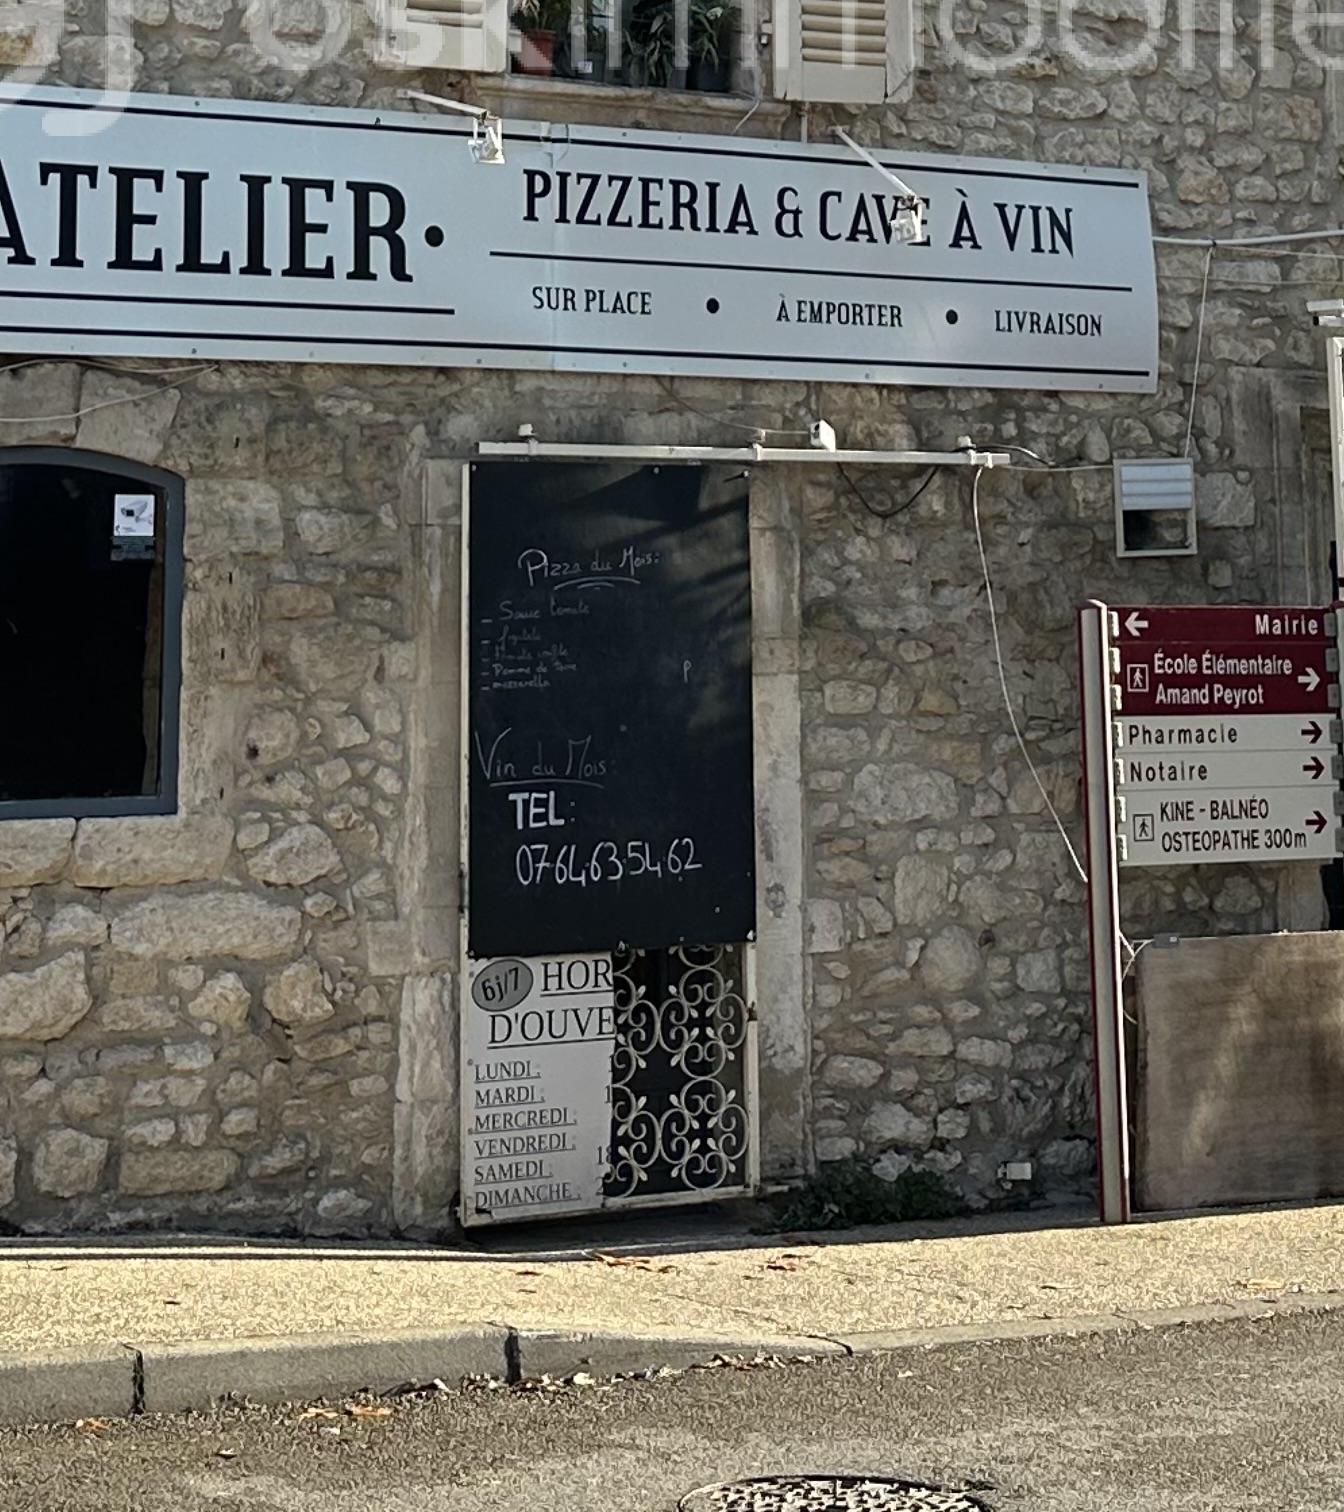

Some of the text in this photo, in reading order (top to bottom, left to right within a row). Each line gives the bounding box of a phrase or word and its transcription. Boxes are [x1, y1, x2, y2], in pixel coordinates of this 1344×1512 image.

[522, 168, 759, 236] PIZZERIA
[774, 186, 804, 239] &
[948, 188, 983, 250] À
[993, 201, 1075, 257] VIN
[531, 285, 652, 316] SUR PLACE
[775, 294, 904, 328] À EMPORTER
[994, 309, 1103, 337] LIVRAISON
[517, 548, 582, 587] Pizza
[590, 549, 613, 572] du
[1255, 613, 1319, 636] Mairie
[1153, 648, 1293, 675] École Élémentaire
[1155, 683, 1265, 709] Amand Peyrot
[1129, 722, 1239, 745] Pharmacie
[474, 727, 517, 780] Vin
[531, 740, 556, 777] du
[1130, 760, 1208, 783] Notaire
[1160, 800, 1195, 823] KINE
[1210, 794, 1270, 820] BALNÉO
[1161, 828, 1307, 852] OSTEOPATHE 300m
[480, 967, 519, 1003] 6j/7
[540, 959, 613, 992] HOR
[488, 1006, 615, 1044] D'OUVE
